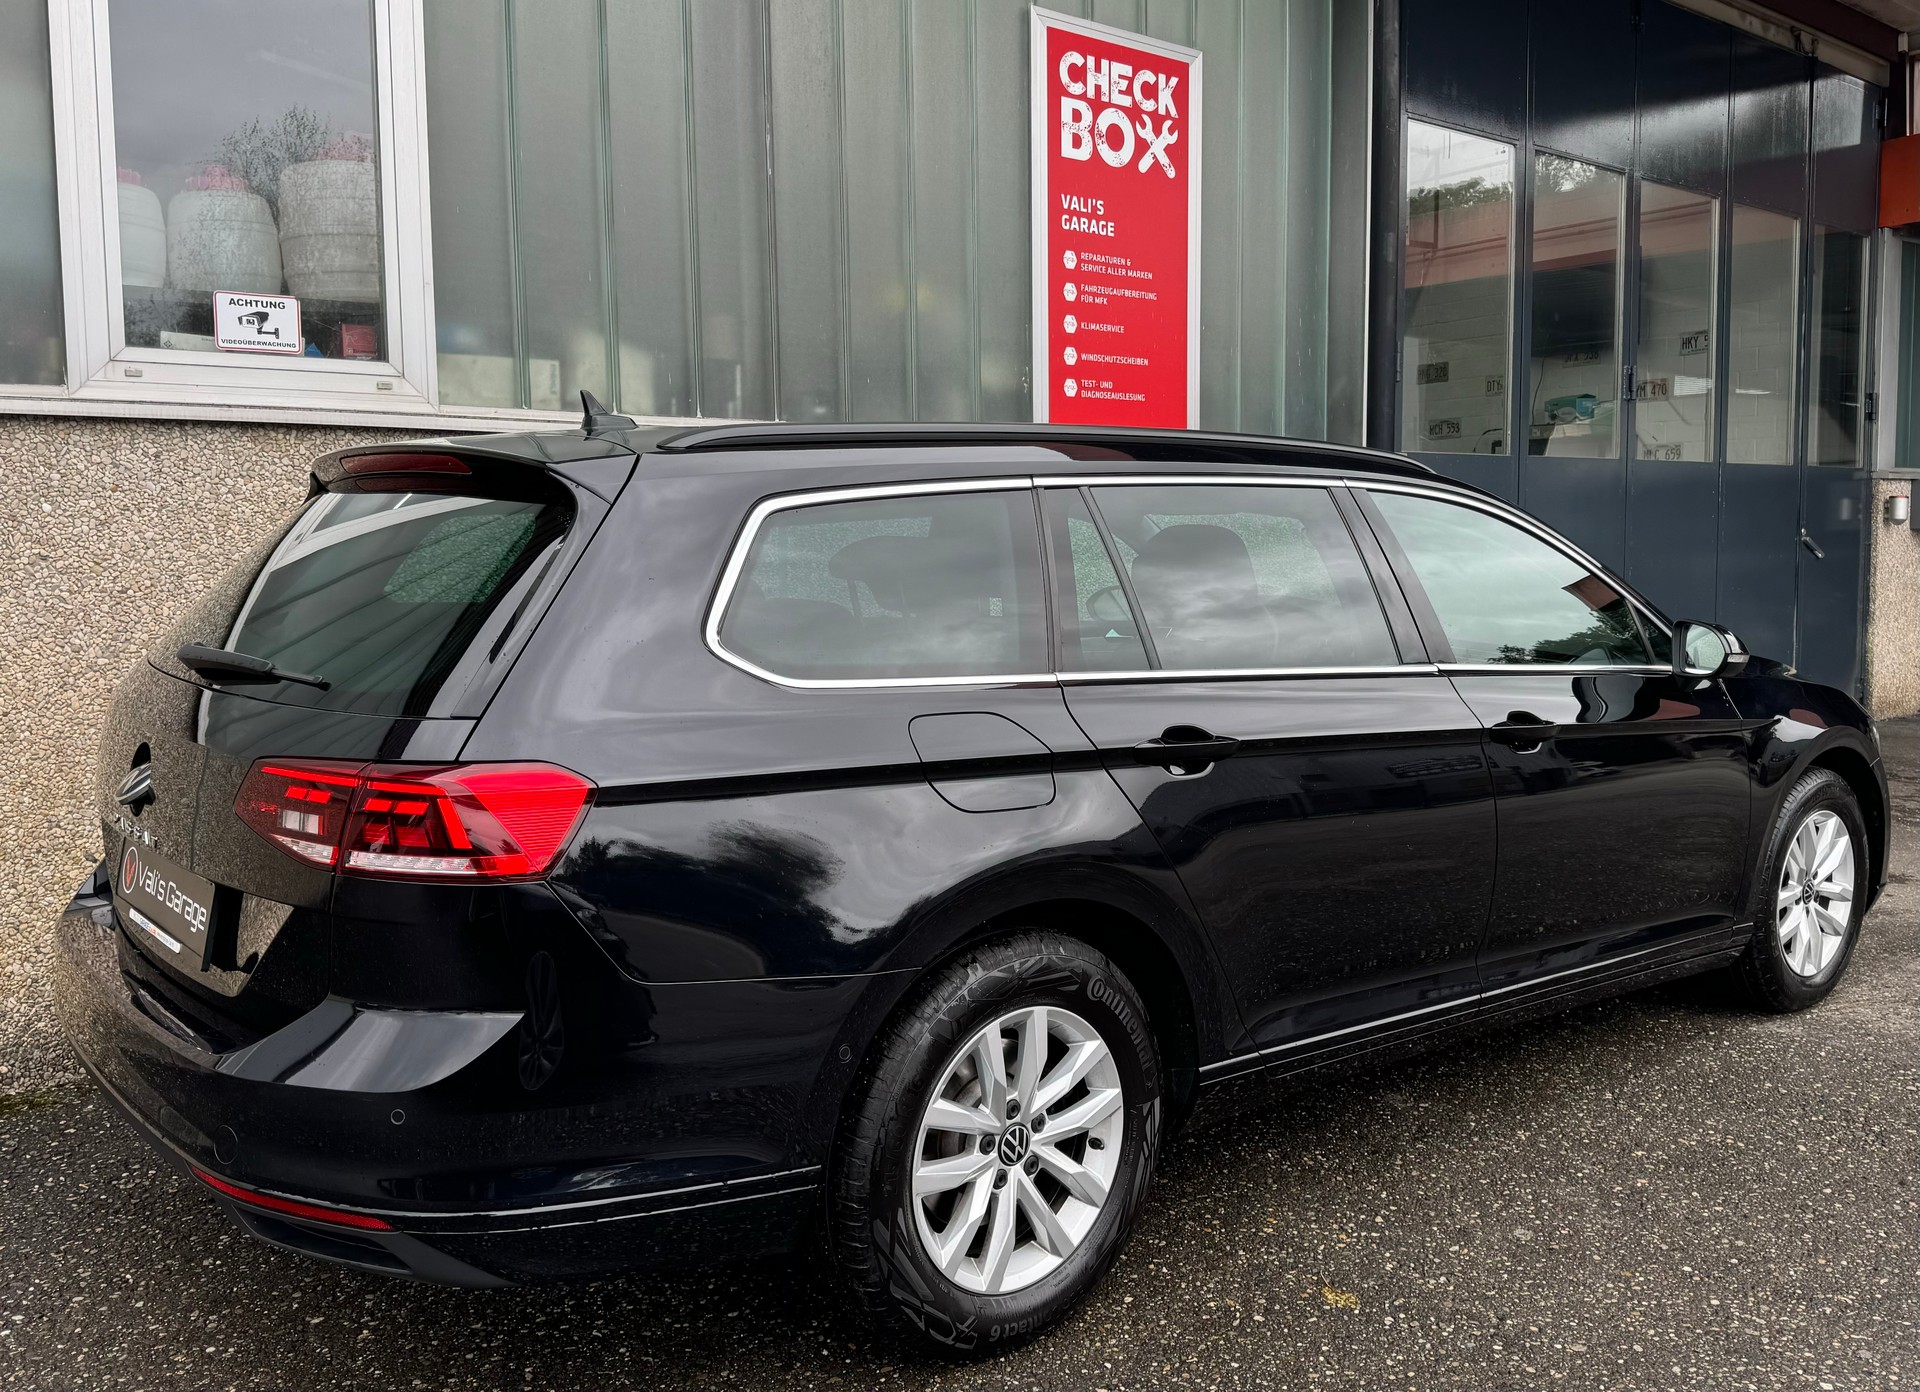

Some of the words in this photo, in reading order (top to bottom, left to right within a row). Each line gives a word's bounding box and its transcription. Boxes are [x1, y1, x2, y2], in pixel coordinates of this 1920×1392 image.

[1059, 51, 1179, 118] CHECK
[1061, 96, 1179, 179] BOX
[1061, 193, 1105, 215] VALI'S
[1061, 214, 1115, 237] GARAGE
[1080, 252, 1126, 266] REPARATUREN
[1126, 258, 1131, 267] &
[1080, 263, 1106, 274] SERVICE
[1107, 267, 1127, 277] ALLER
[1127, 270, 1153, 280] MARKEN
[1080, 284, 1157, 300] FAHRZEUGAUFBEREITUNG
[1080, 294, 1094, 303] FÜR
[1094, 296, 1108, 305] MFK
[228, 297, 286, 310] ACHTUNG
[1080, 321, 1125, 334] KLIMASERVICE
[220, 338, 297, 349] VIDEOÜBERWACHUNG
[1682, 336, 1699, 351] HKY
[1080, 352, 1149, 366] WINDSCHUTZSCHEIBEN
[1081, 379, 1099, 388] TEST-
[1099, 381, 1113, 389] UND
[1650, 382, 1668, 397] 470
[1081, 390, 1146, 402] DIAGNOSEAUSLESUNG
[1446, 422, 1460, 434] 553
[1664, 447, 1682, 460] 659
[139, 860, 166, 902] Vali's
[165, 881, 207, 934] Garage
[1086, 976, 1155, 1073] Continental
